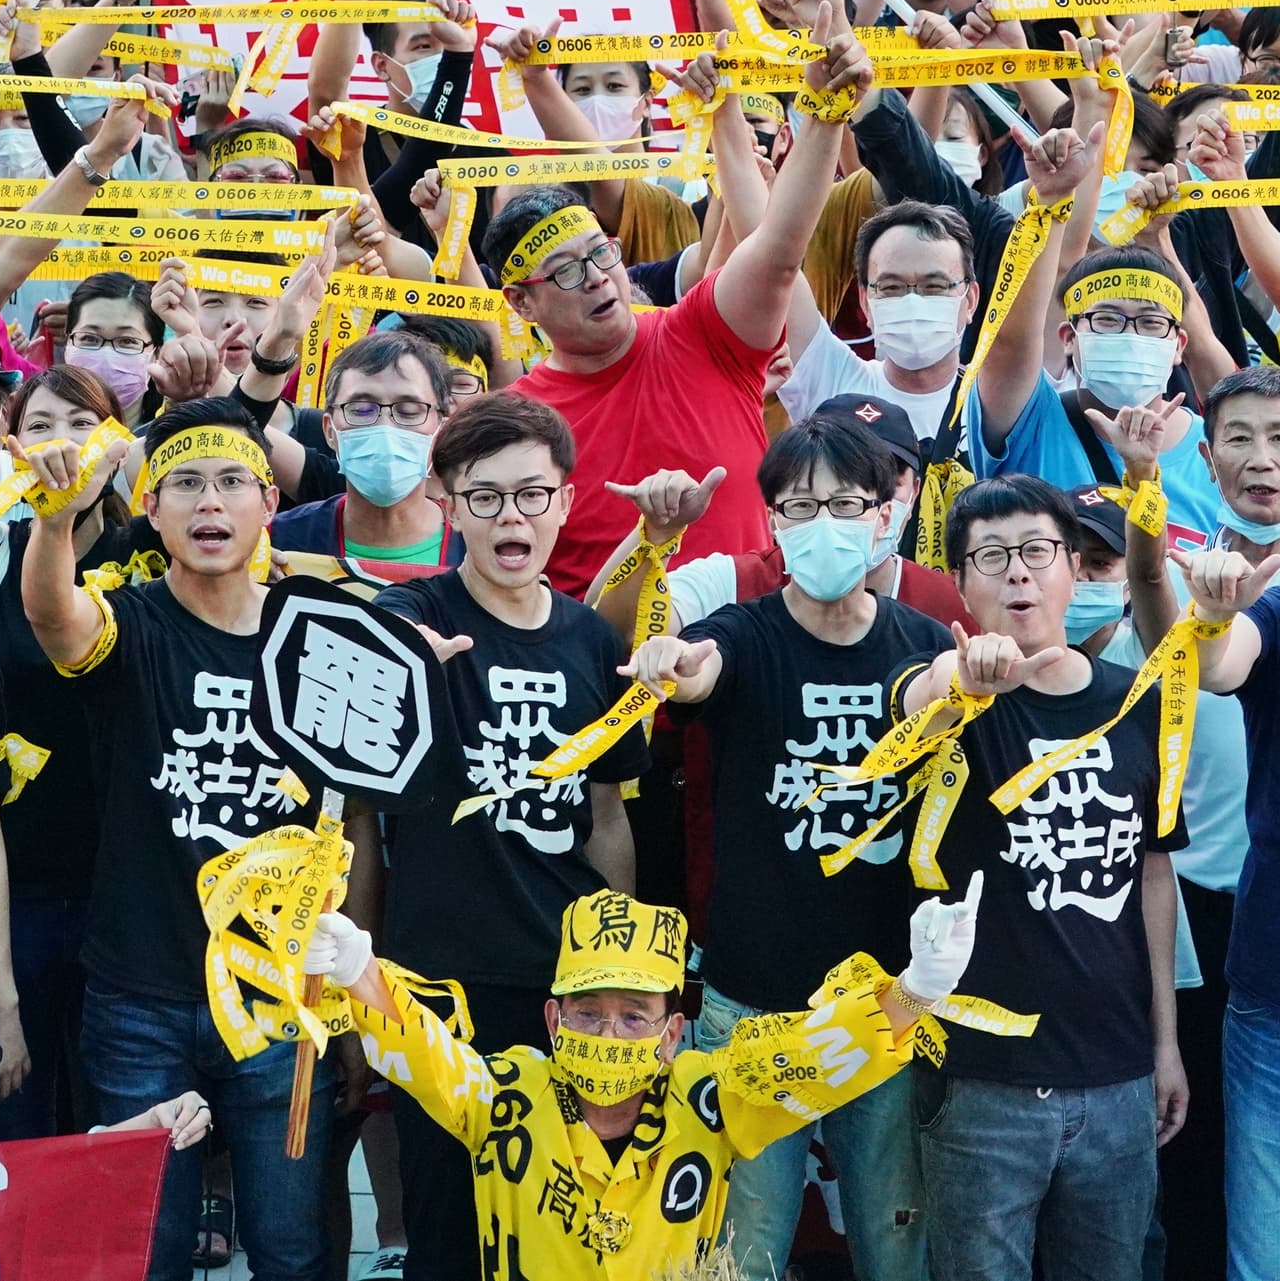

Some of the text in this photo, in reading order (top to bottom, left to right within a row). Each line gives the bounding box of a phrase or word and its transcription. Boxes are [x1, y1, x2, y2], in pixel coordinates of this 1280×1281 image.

[1235, 102, 1262, 120] We
[28, 218, 121, 239] 高雄人寫歷史
[152, 226, 200, 243] 0606
[203, 226, 265, 246] 天佑台灣
[158, 436, 194, 466] 2020
[292, 620, 409, 774] 罷
[564, 1038, 647, 1065] 高雄人寫歷史
